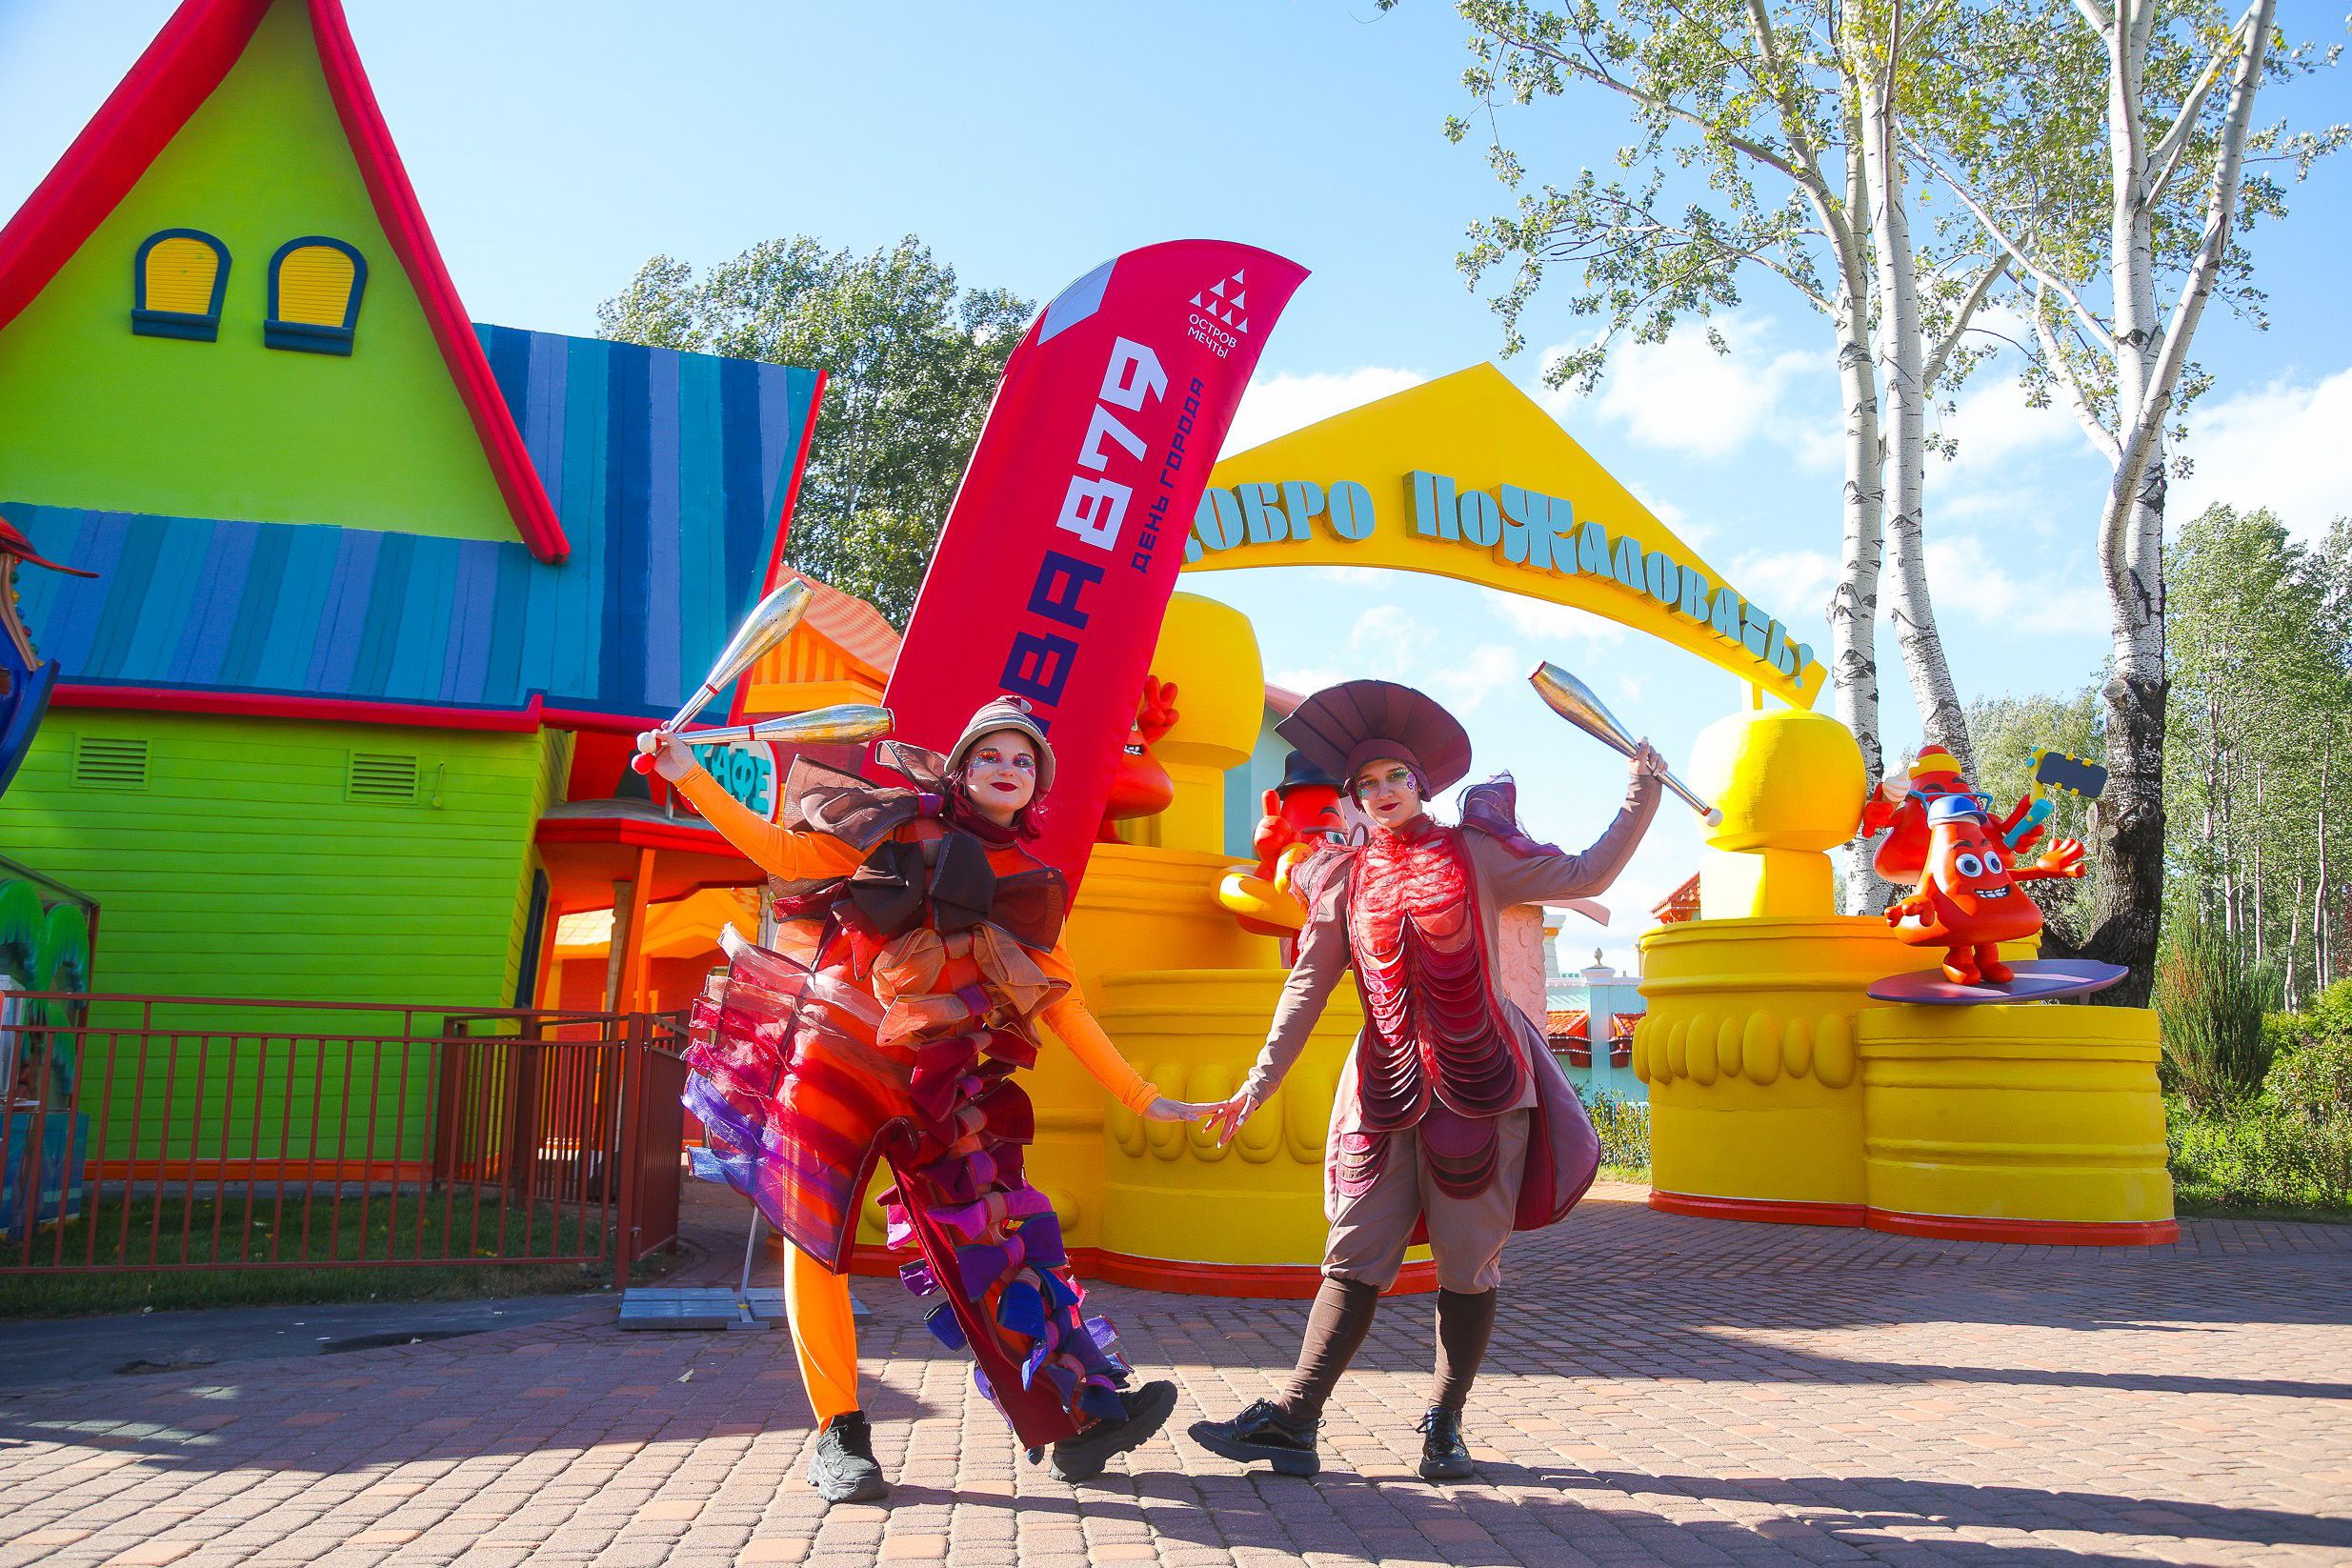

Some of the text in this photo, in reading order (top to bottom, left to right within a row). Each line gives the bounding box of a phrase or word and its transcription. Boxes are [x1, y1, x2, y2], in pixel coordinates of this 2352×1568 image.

[1186, 325, 1230, 360] МЕЧТЫ
[1188, 312, 1237, 349] ОСТРОВ
[1055, 335, 1169, 553] 879
[1130, 376, 1205, 574] ДЕНЬ ГОРОДА
